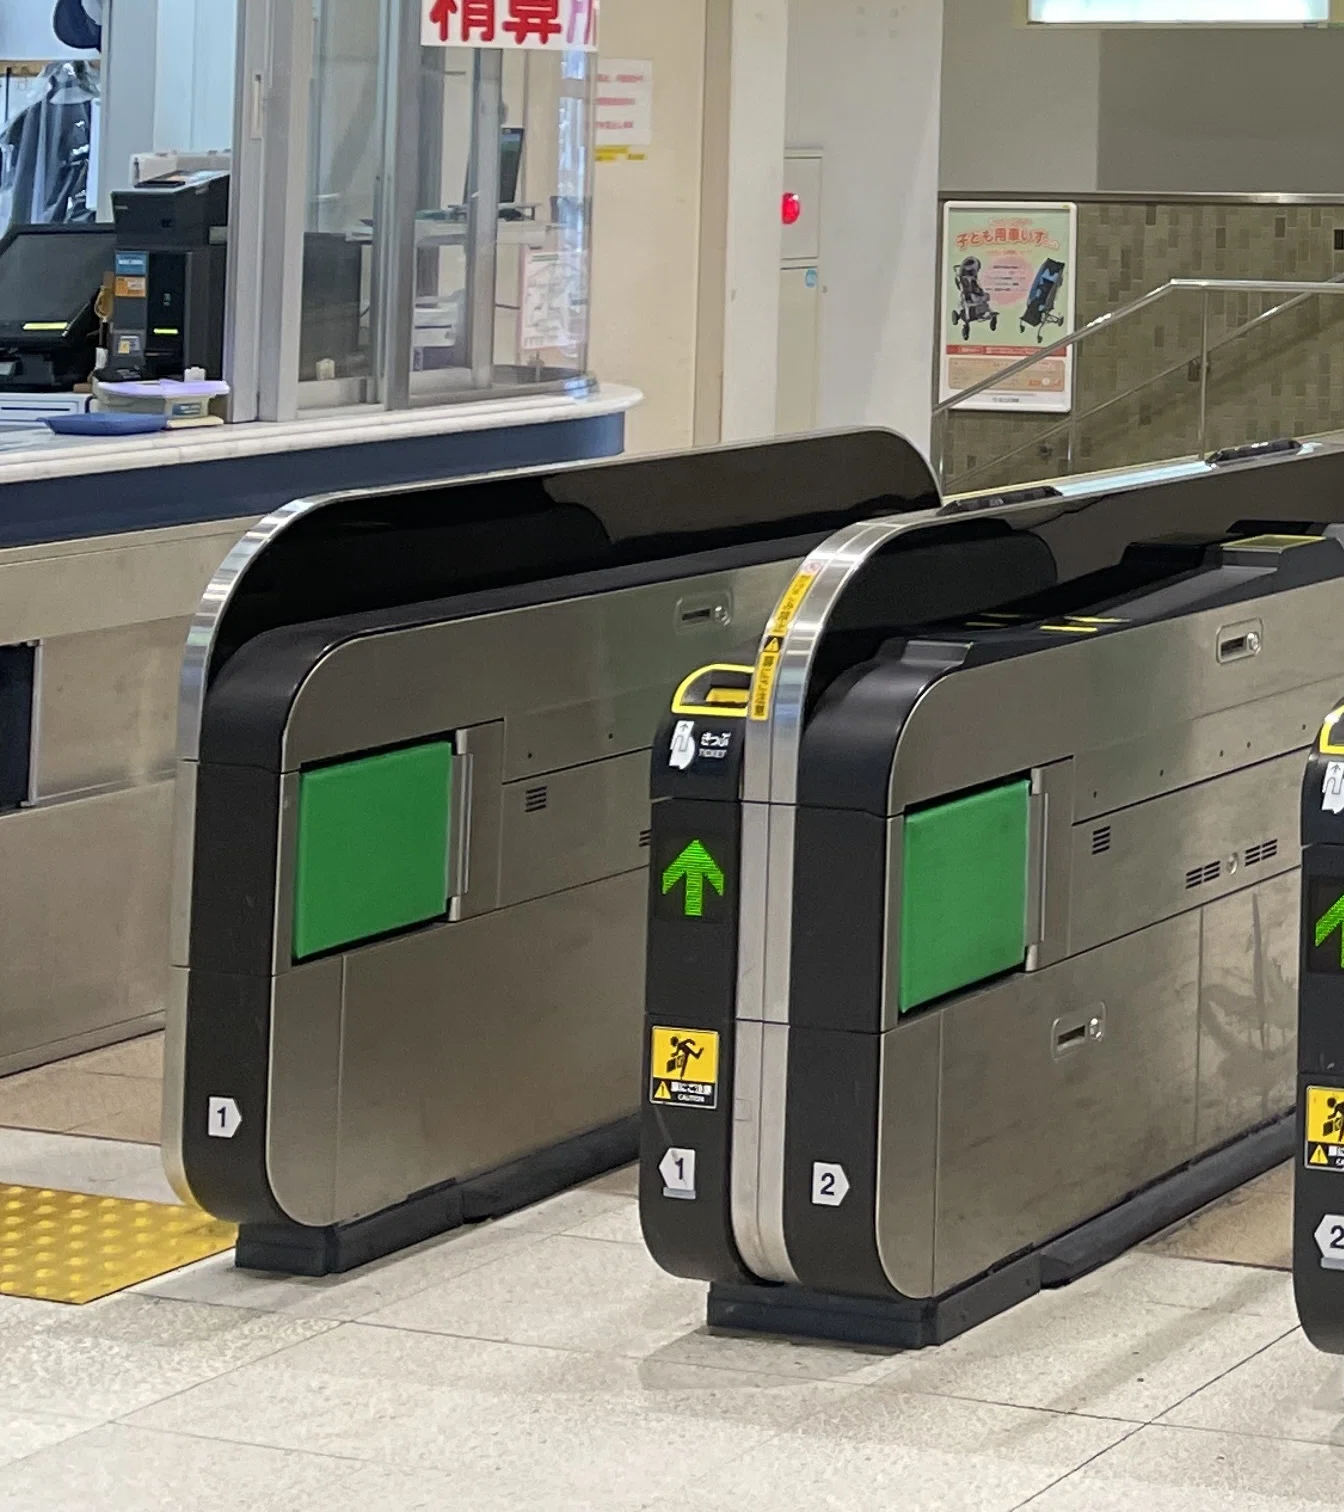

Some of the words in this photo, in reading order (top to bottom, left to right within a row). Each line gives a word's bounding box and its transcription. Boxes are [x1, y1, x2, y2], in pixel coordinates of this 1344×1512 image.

[215, 1106, 230, 1129] 1
[674, 1157, 685, 1180] 1
[819, 1172, 836, 1196] 2
